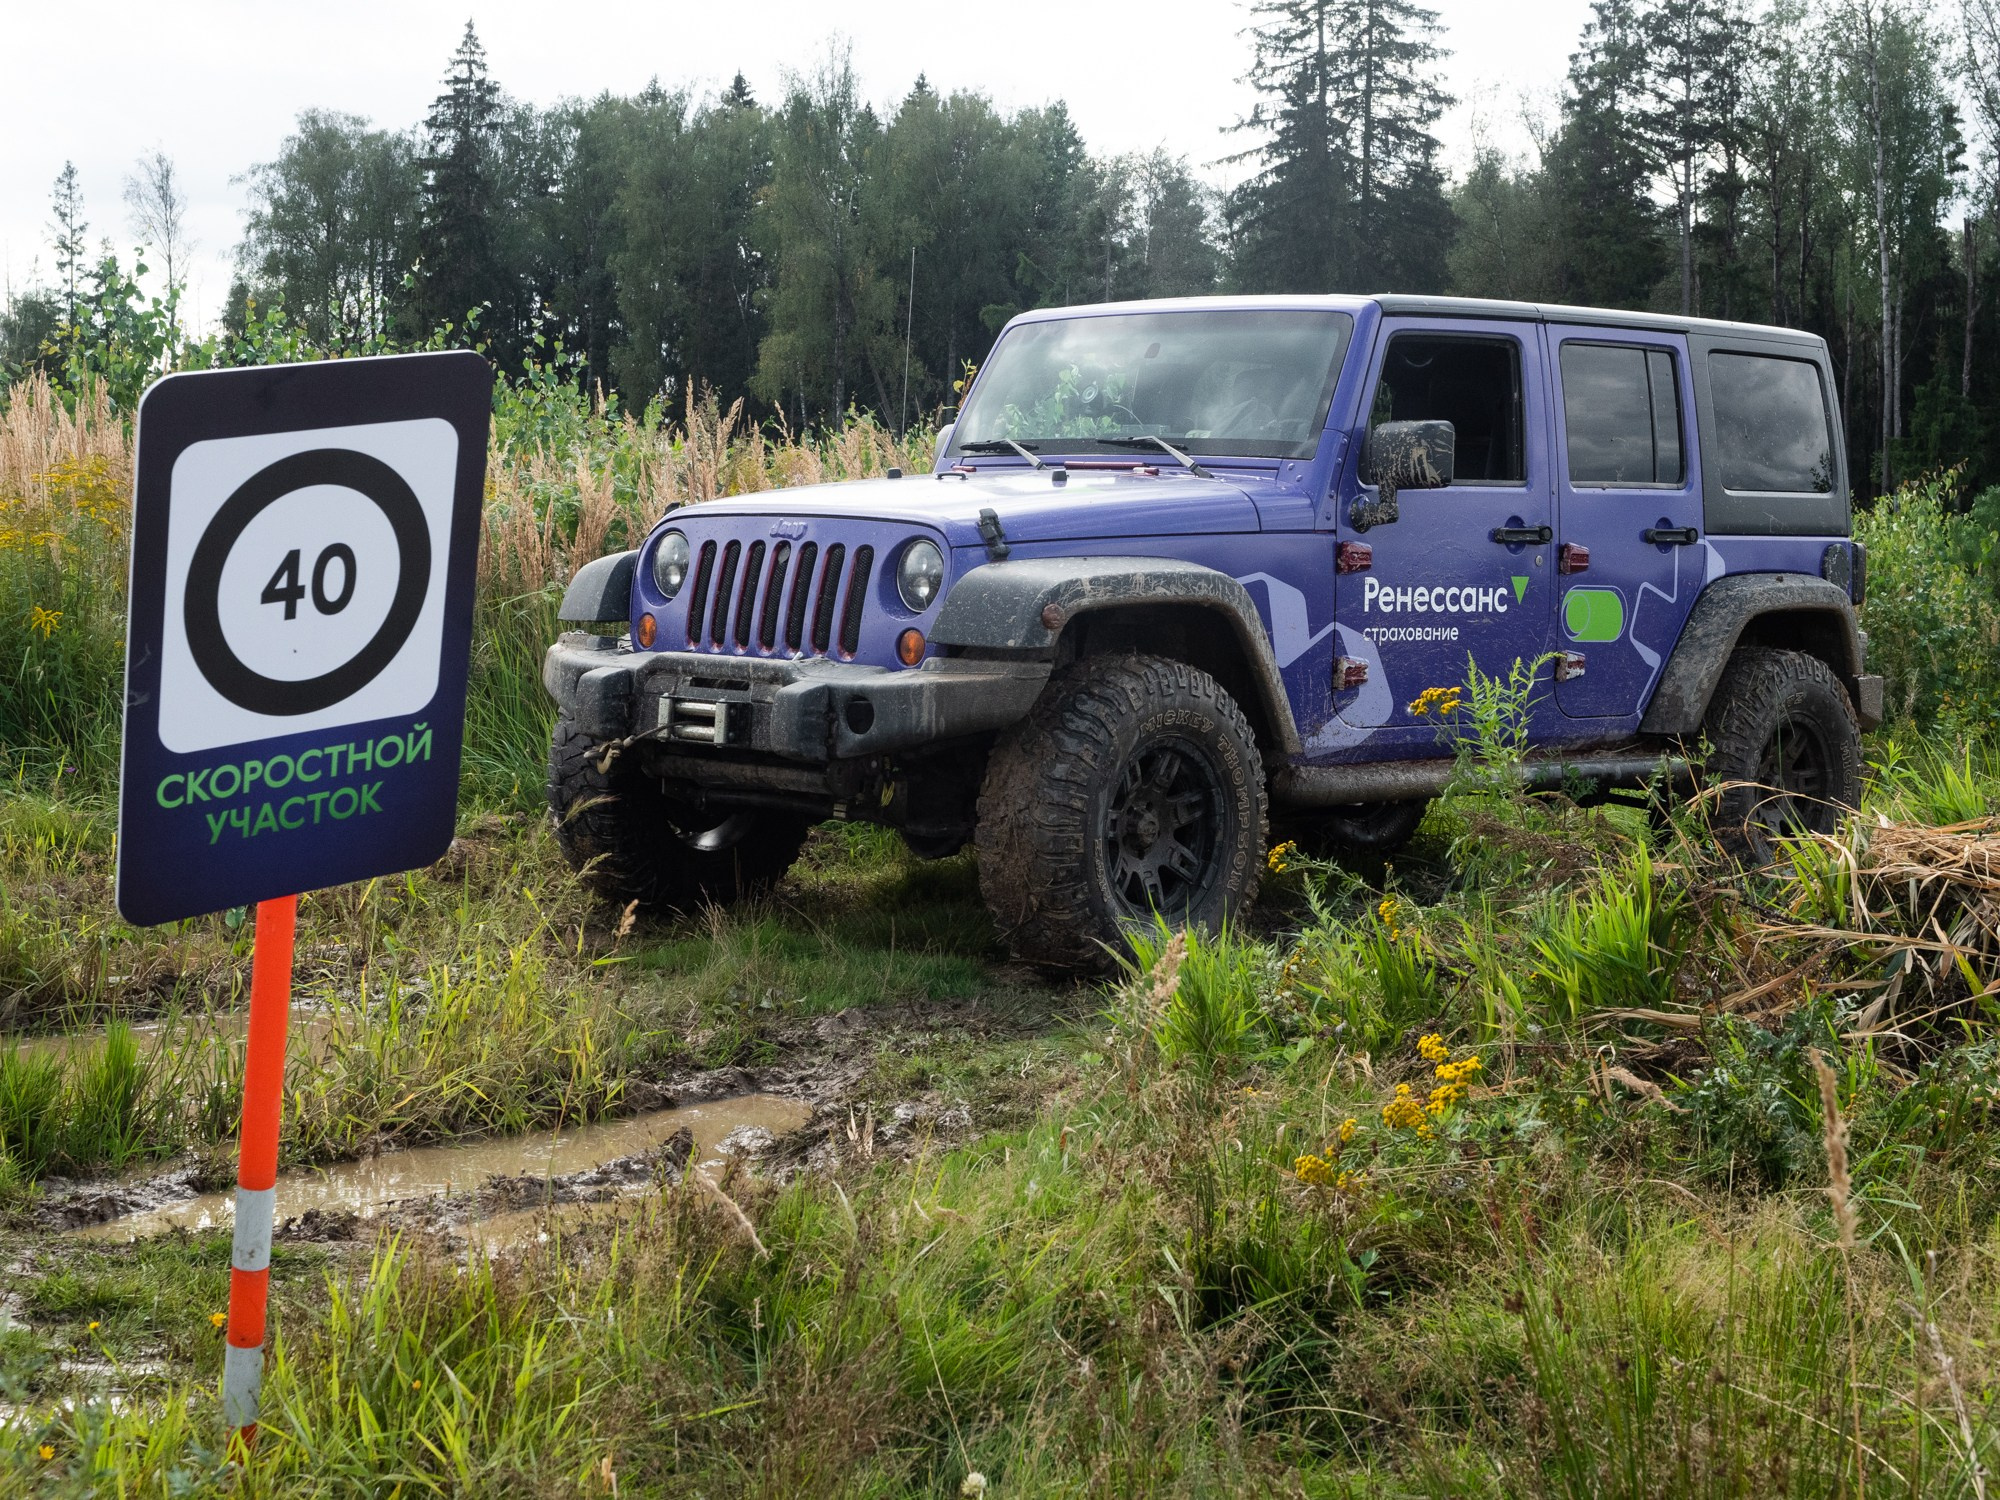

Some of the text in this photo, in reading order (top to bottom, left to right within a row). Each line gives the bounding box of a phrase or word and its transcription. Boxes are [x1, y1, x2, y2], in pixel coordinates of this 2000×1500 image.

[260, 542, 357, 621] 40
[1364, 577, 1508, 613] Ренессанс
[1363, 626, 1459, 646] страхование
[156, 722, 433, 809] СКОРОСТНОЙ
[1140, 708, 1250, 892] MICKEY THOMPSON
[206, 781, 383, 845] УЧАСТОК
